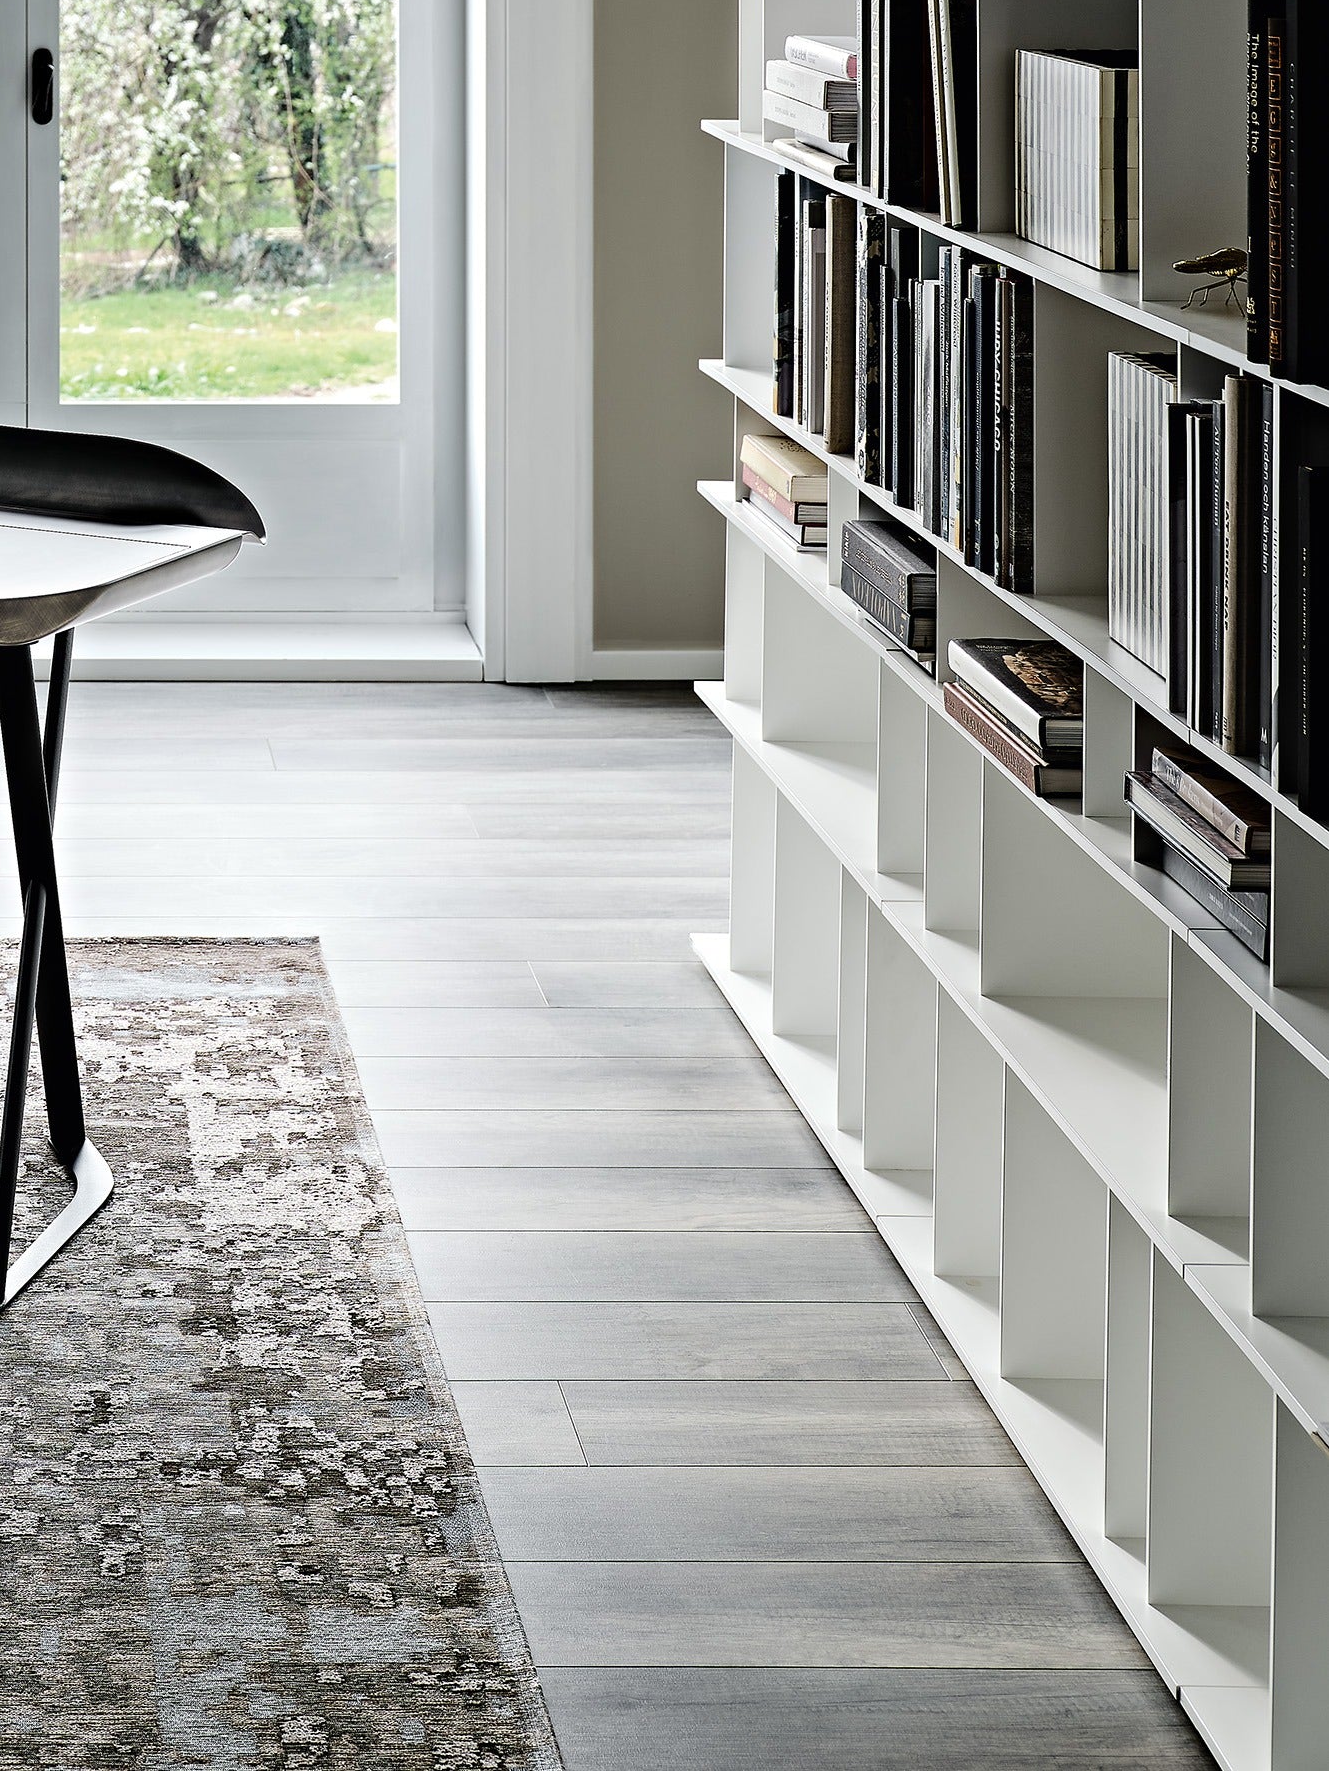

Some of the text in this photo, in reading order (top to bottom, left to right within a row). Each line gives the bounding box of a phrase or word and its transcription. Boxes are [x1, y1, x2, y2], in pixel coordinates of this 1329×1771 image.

[1249, 33, 1259, 153] The Image of the
[1263, 420, 1271, 574] Handen och känslan
